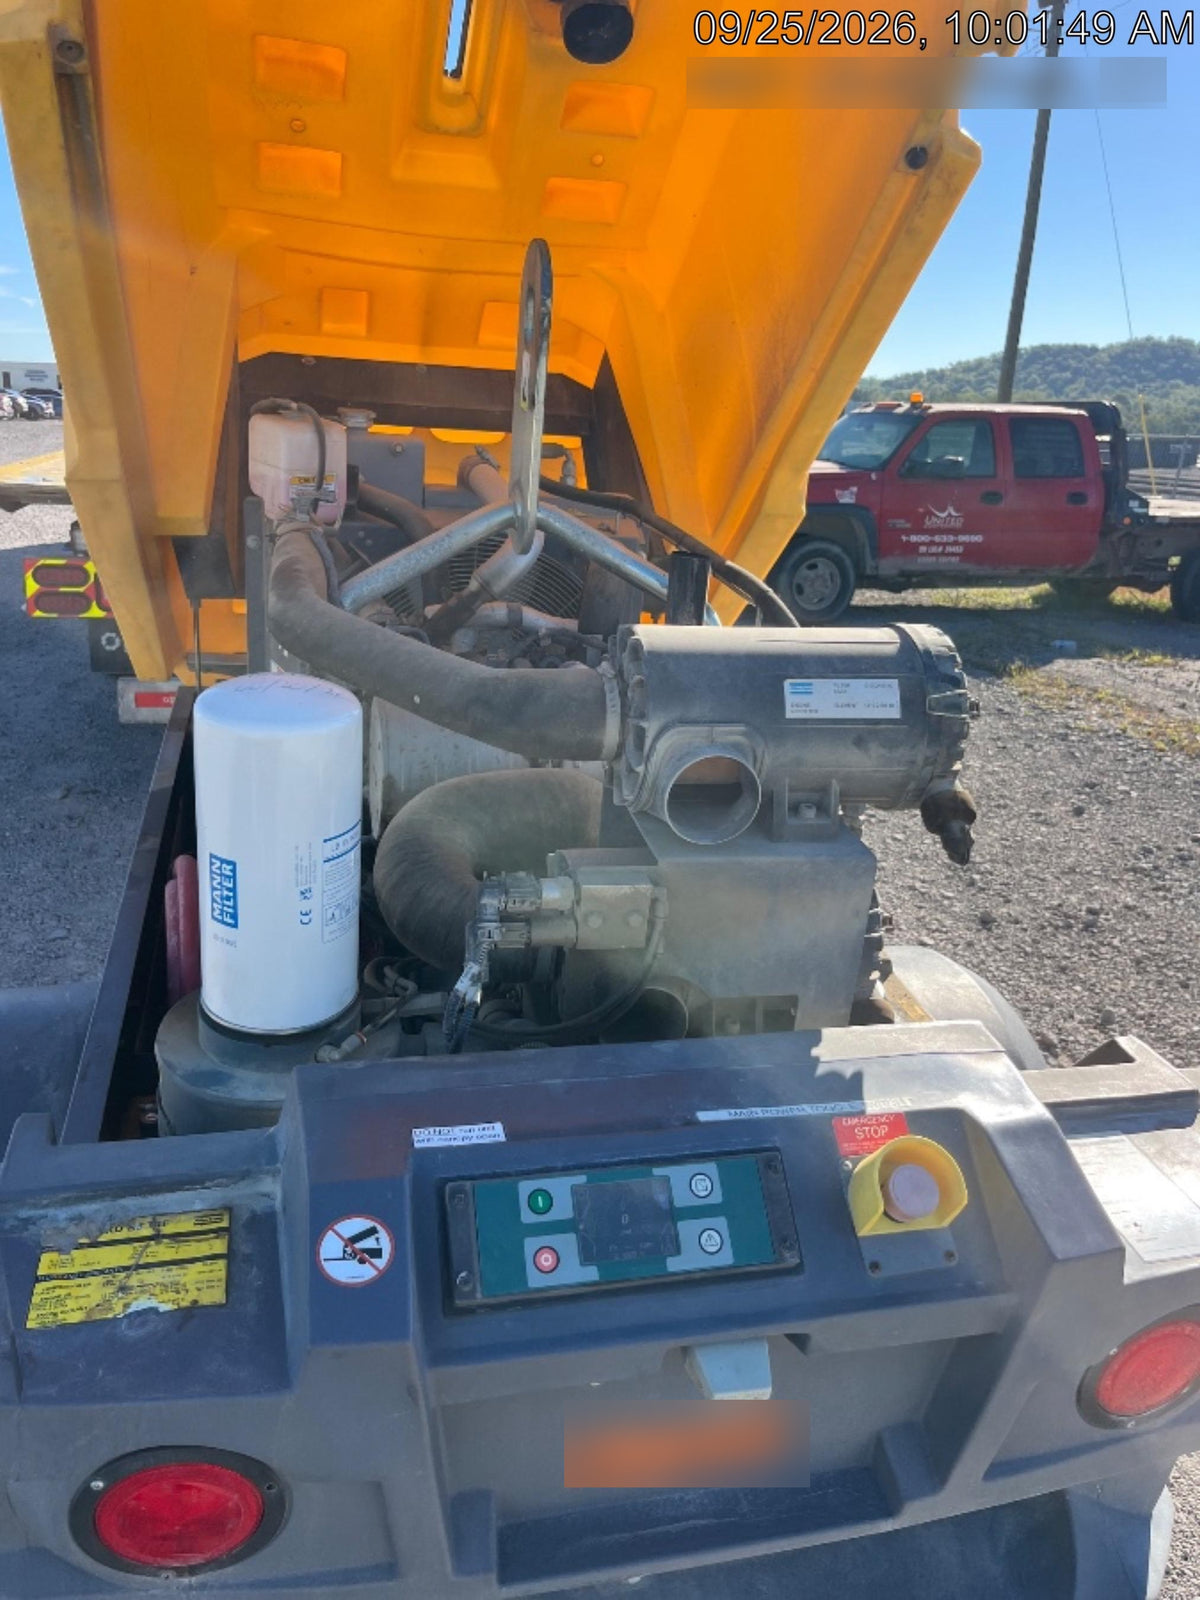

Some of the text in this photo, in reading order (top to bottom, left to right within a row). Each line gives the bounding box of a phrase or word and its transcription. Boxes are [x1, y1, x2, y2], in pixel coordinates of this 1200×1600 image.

[211, 857, 222, 920] MANN
[221, 863, 236, 925] FILTER
[842, 1114, 895, 1126] EMERGENCY
[854, 1125, 889, 1140] STOP
